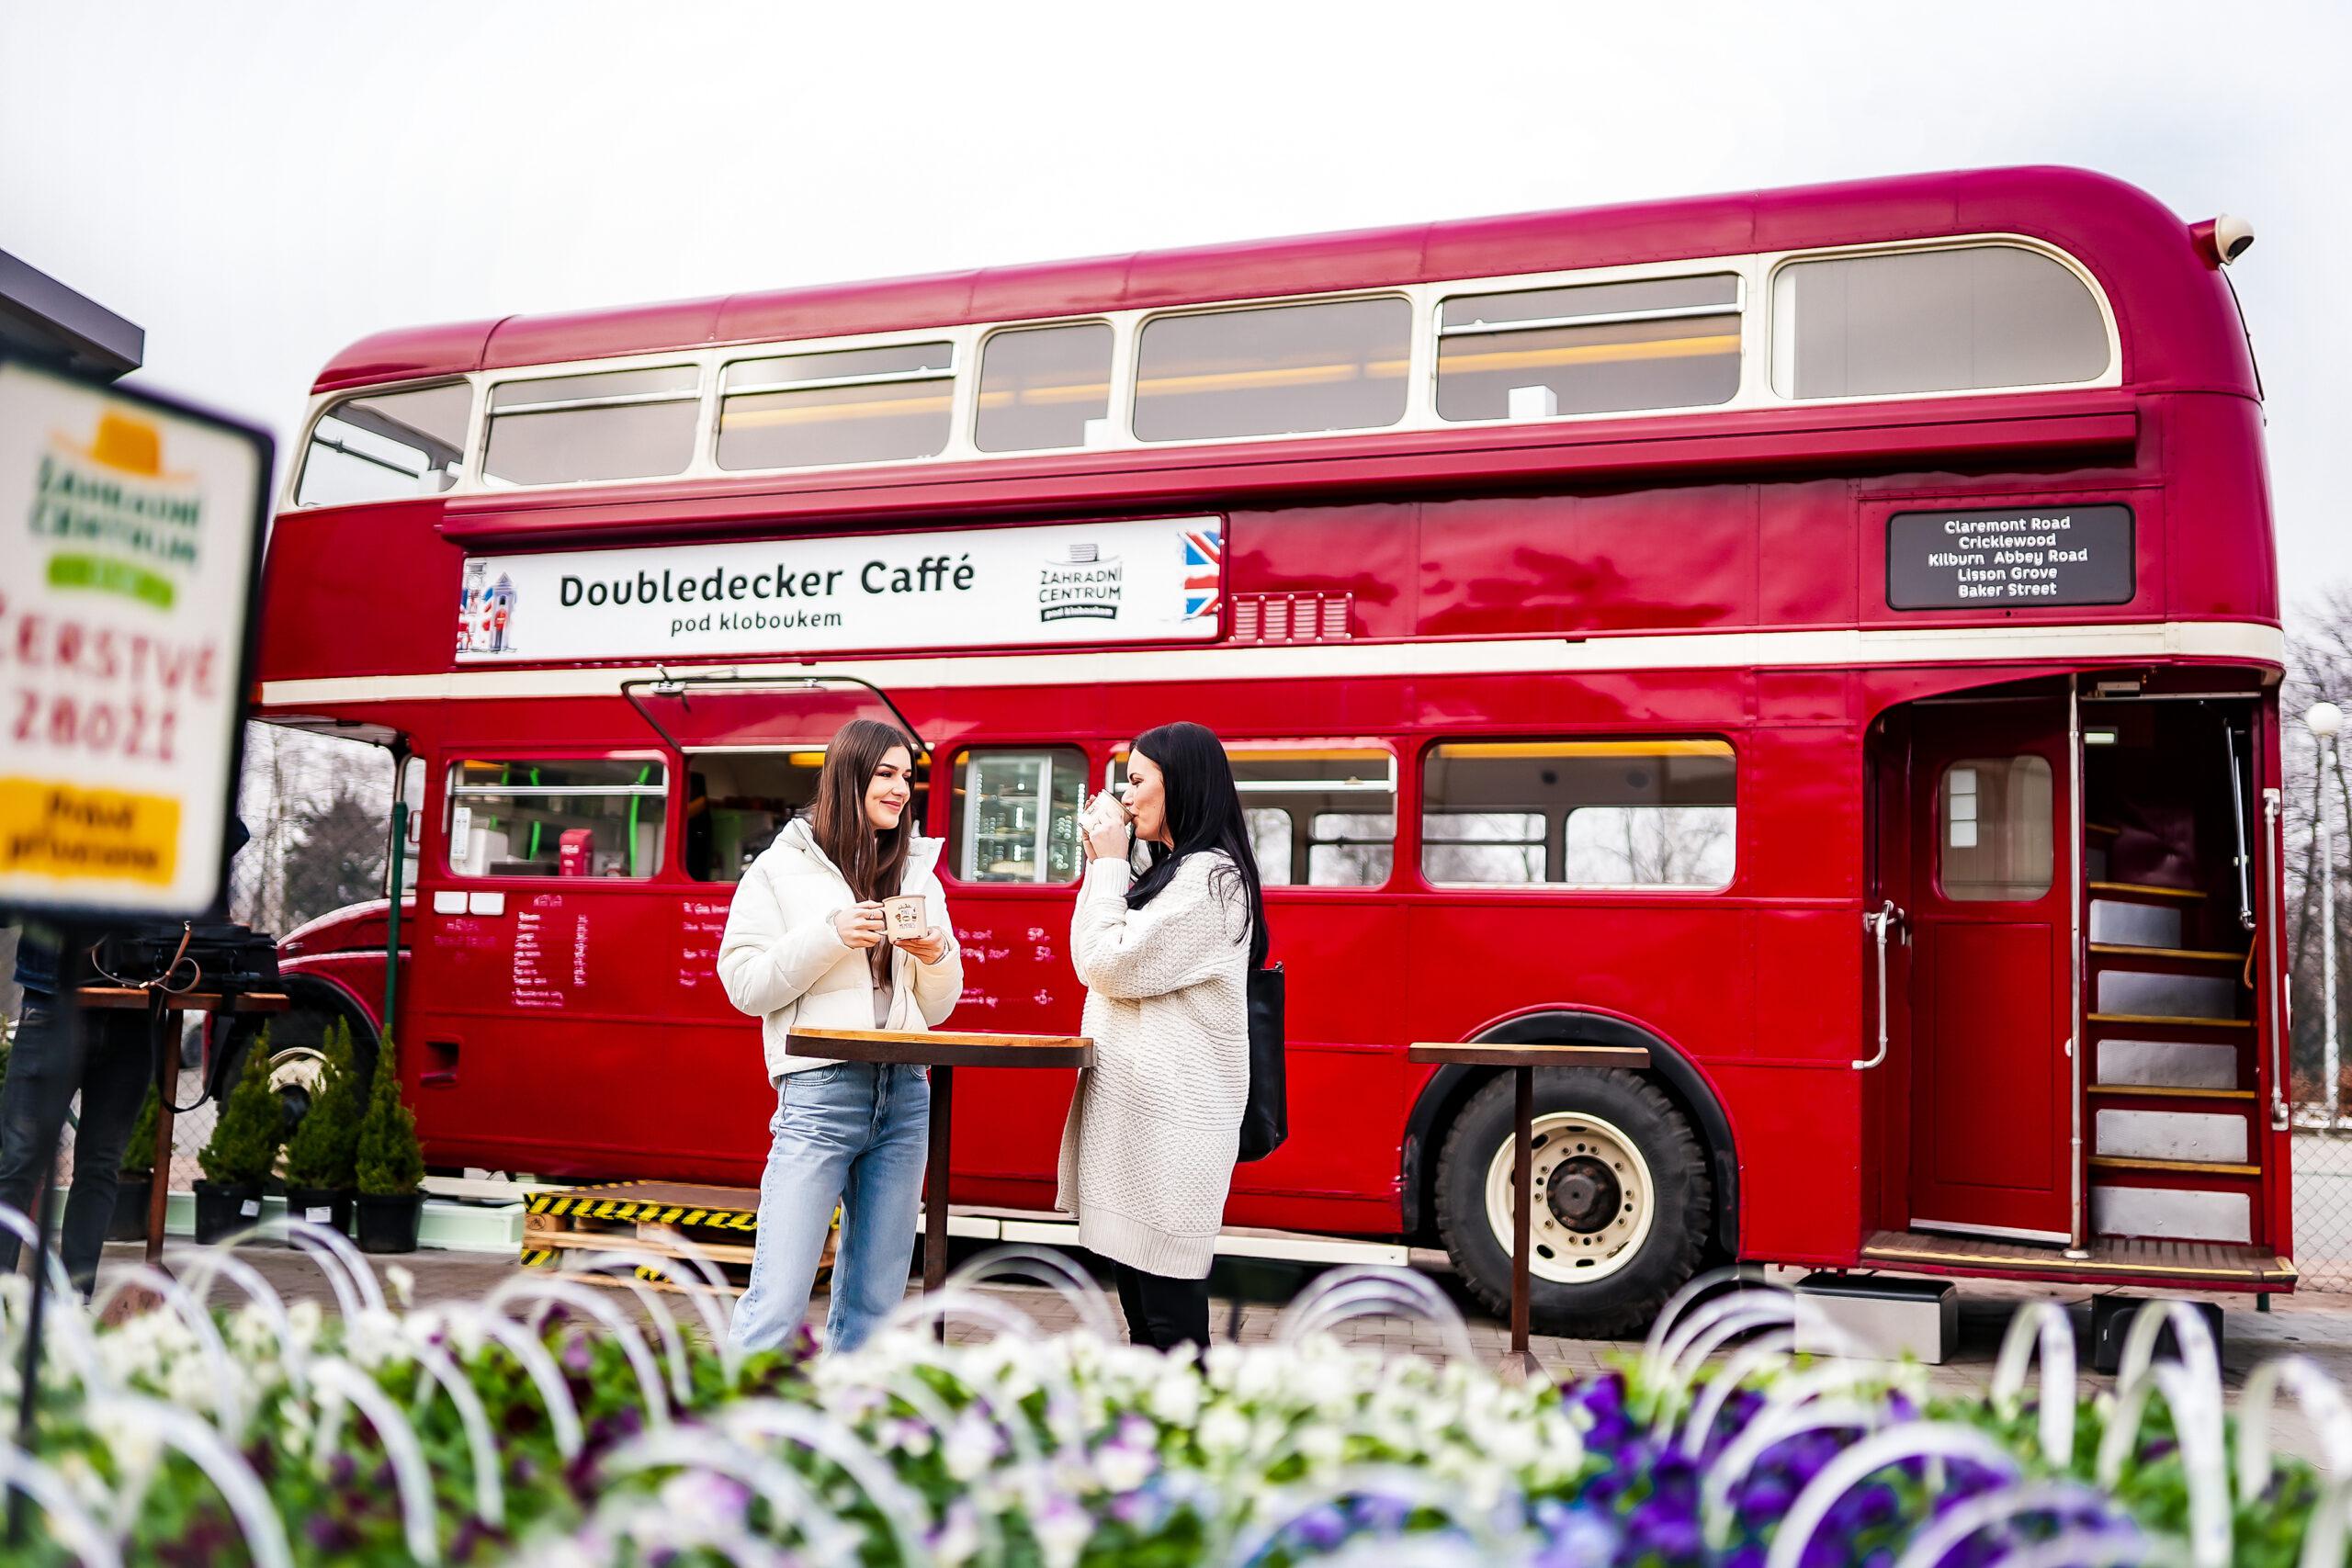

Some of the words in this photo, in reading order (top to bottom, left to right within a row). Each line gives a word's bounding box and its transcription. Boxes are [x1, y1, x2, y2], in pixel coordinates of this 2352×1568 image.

[1944, 518, 2027, 535] Claremont
[2030, 516, 2071, 531] Road
[1958, 533, 2057, 549] Cricklewood
[1928, 553, 1985, 567] Kilburn
[1994, 549, 2043, 566] Abbey
[2048, 548, 2088, 562] Road
[560, 562, 843, 607] Doubledecker
[860, 552, 975, 594] Caffé
[1040, 561, 1123, 585] ZAHRADNÍ
[1957, 568, 2007, 582] Lisson
[2010, 566, 2058, 581] Grove
[1039, 586, 1121, 604] CENTRUM
[1958, 583, 2004, 598] Baker
[2007, 581, 2057, 597] Street
[671, 613, 711, 637] pod
[719, 609, 842, 631] kloboukem
